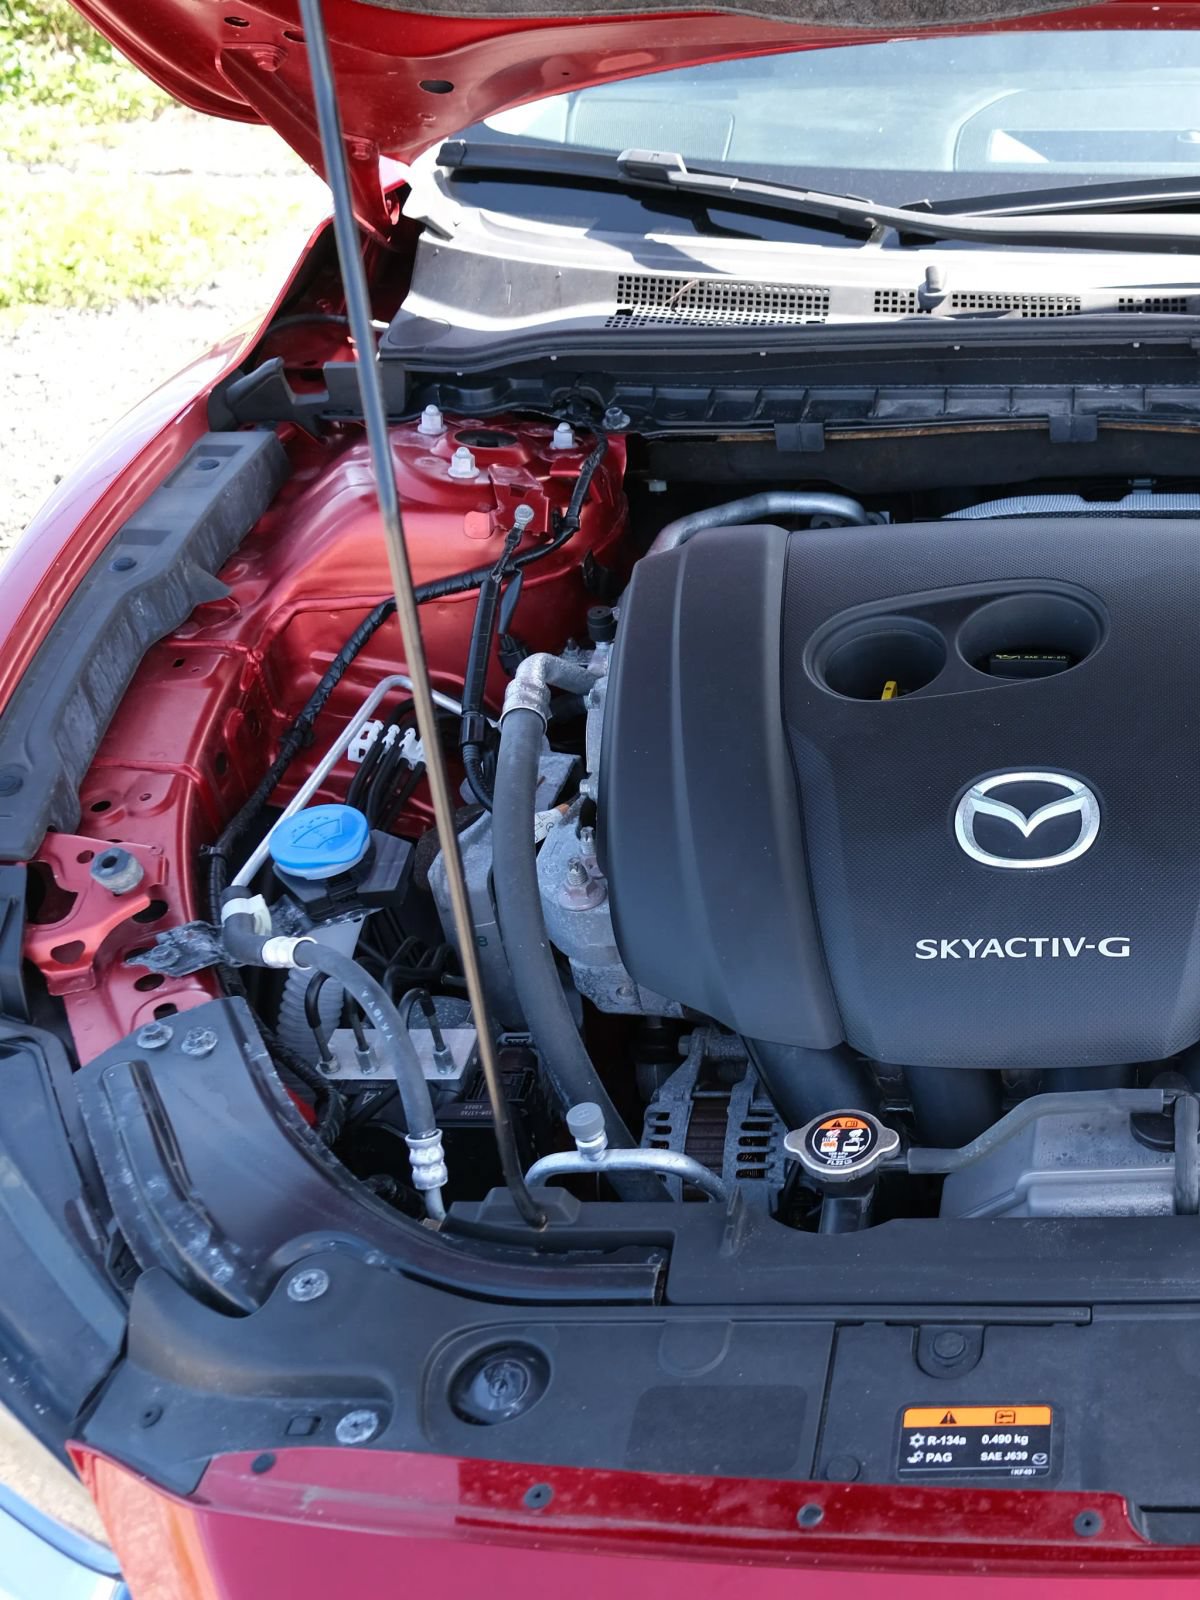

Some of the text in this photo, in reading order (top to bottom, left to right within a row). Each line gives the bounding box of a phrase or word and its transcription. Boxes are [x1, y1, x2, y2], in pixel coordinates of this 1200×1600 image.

[915, 937, 1130, 960] SKYACTIV-G
[927, 1433, 1029, 1446] R-134a 0.490 kg
[925, 1450, 1028, 1463] PAG SAE J639
